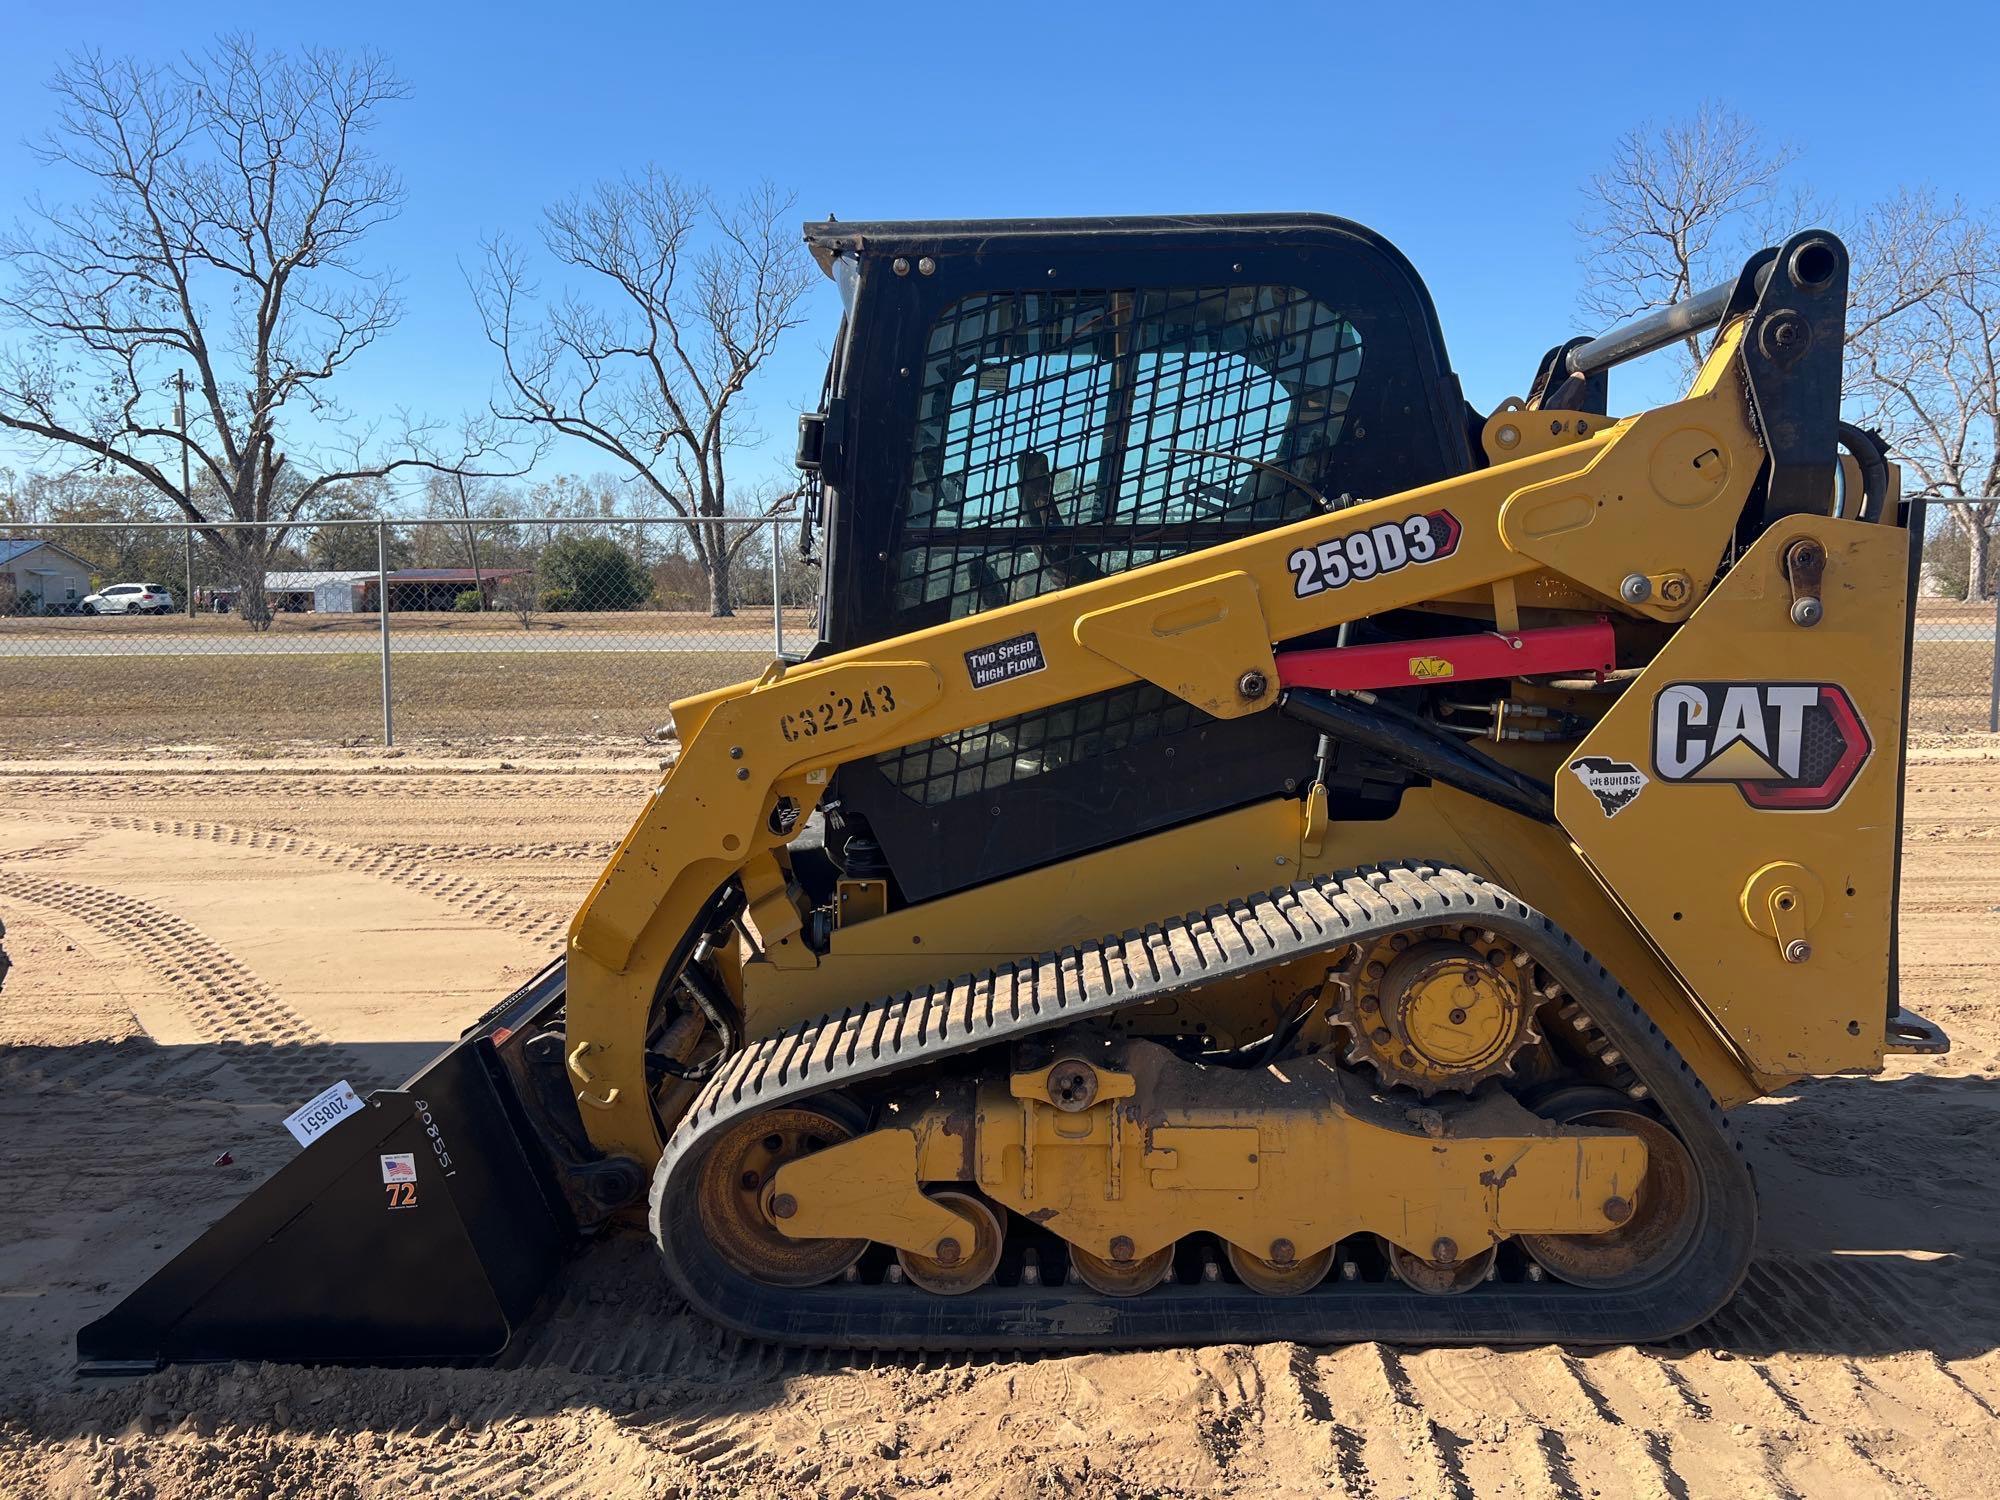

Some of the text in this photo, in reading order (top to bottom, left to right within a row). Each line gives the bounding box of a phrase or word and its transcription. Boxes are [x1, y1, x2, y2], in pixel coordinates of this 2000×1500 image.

[1288, 514, 1437, 597] 259D3
[781, 685, 896, 742] C32243
[1656, 685, 1818, 779] CAT
[300, 1096, 349, 1136] 208551
[385, 1182, 417, 1207] 72
